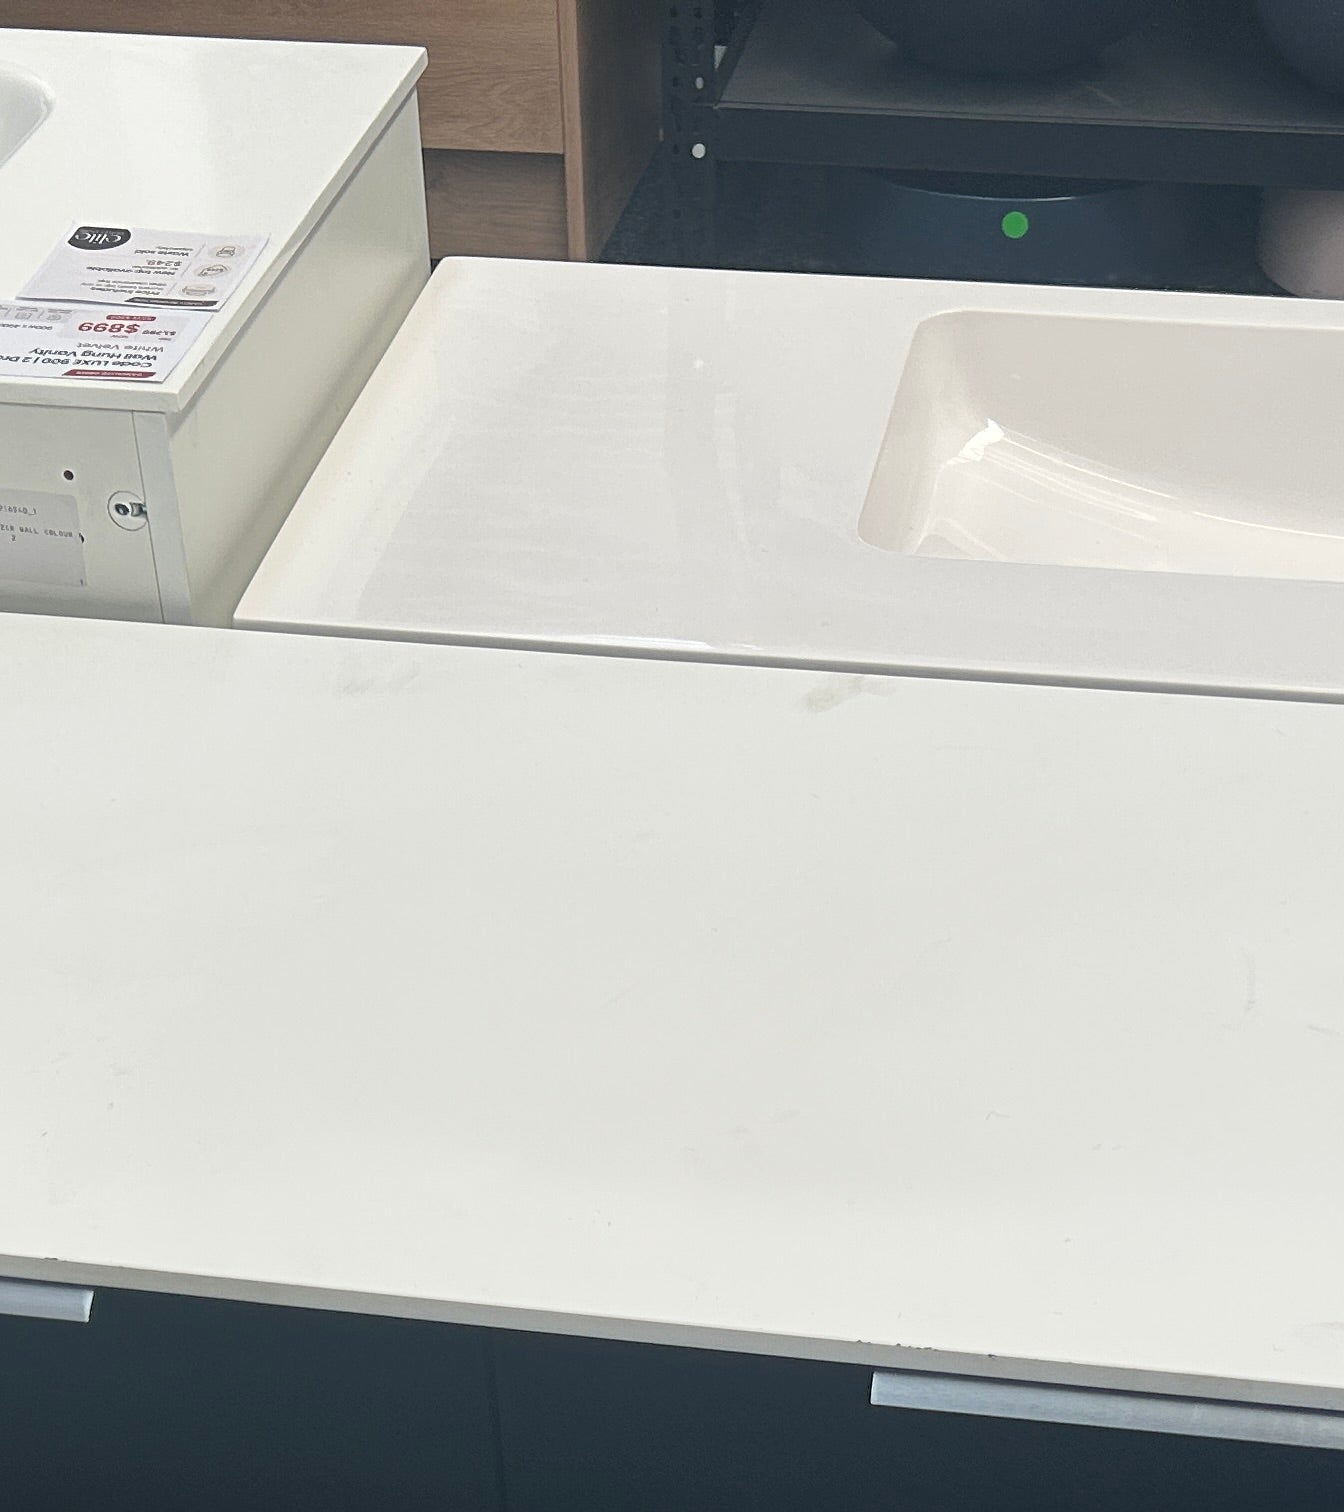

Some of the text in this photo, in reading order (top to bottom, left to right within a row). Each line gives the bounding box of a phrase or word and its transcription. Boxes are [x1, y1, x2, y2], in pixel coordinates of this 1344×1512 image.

[77, 321, 141, 334] $899
[29, 347, 157, 360] Wall Hung Vanity
[77, 342, 164, 353] White Velvet
[73, 359, 111, 367] LUXE
